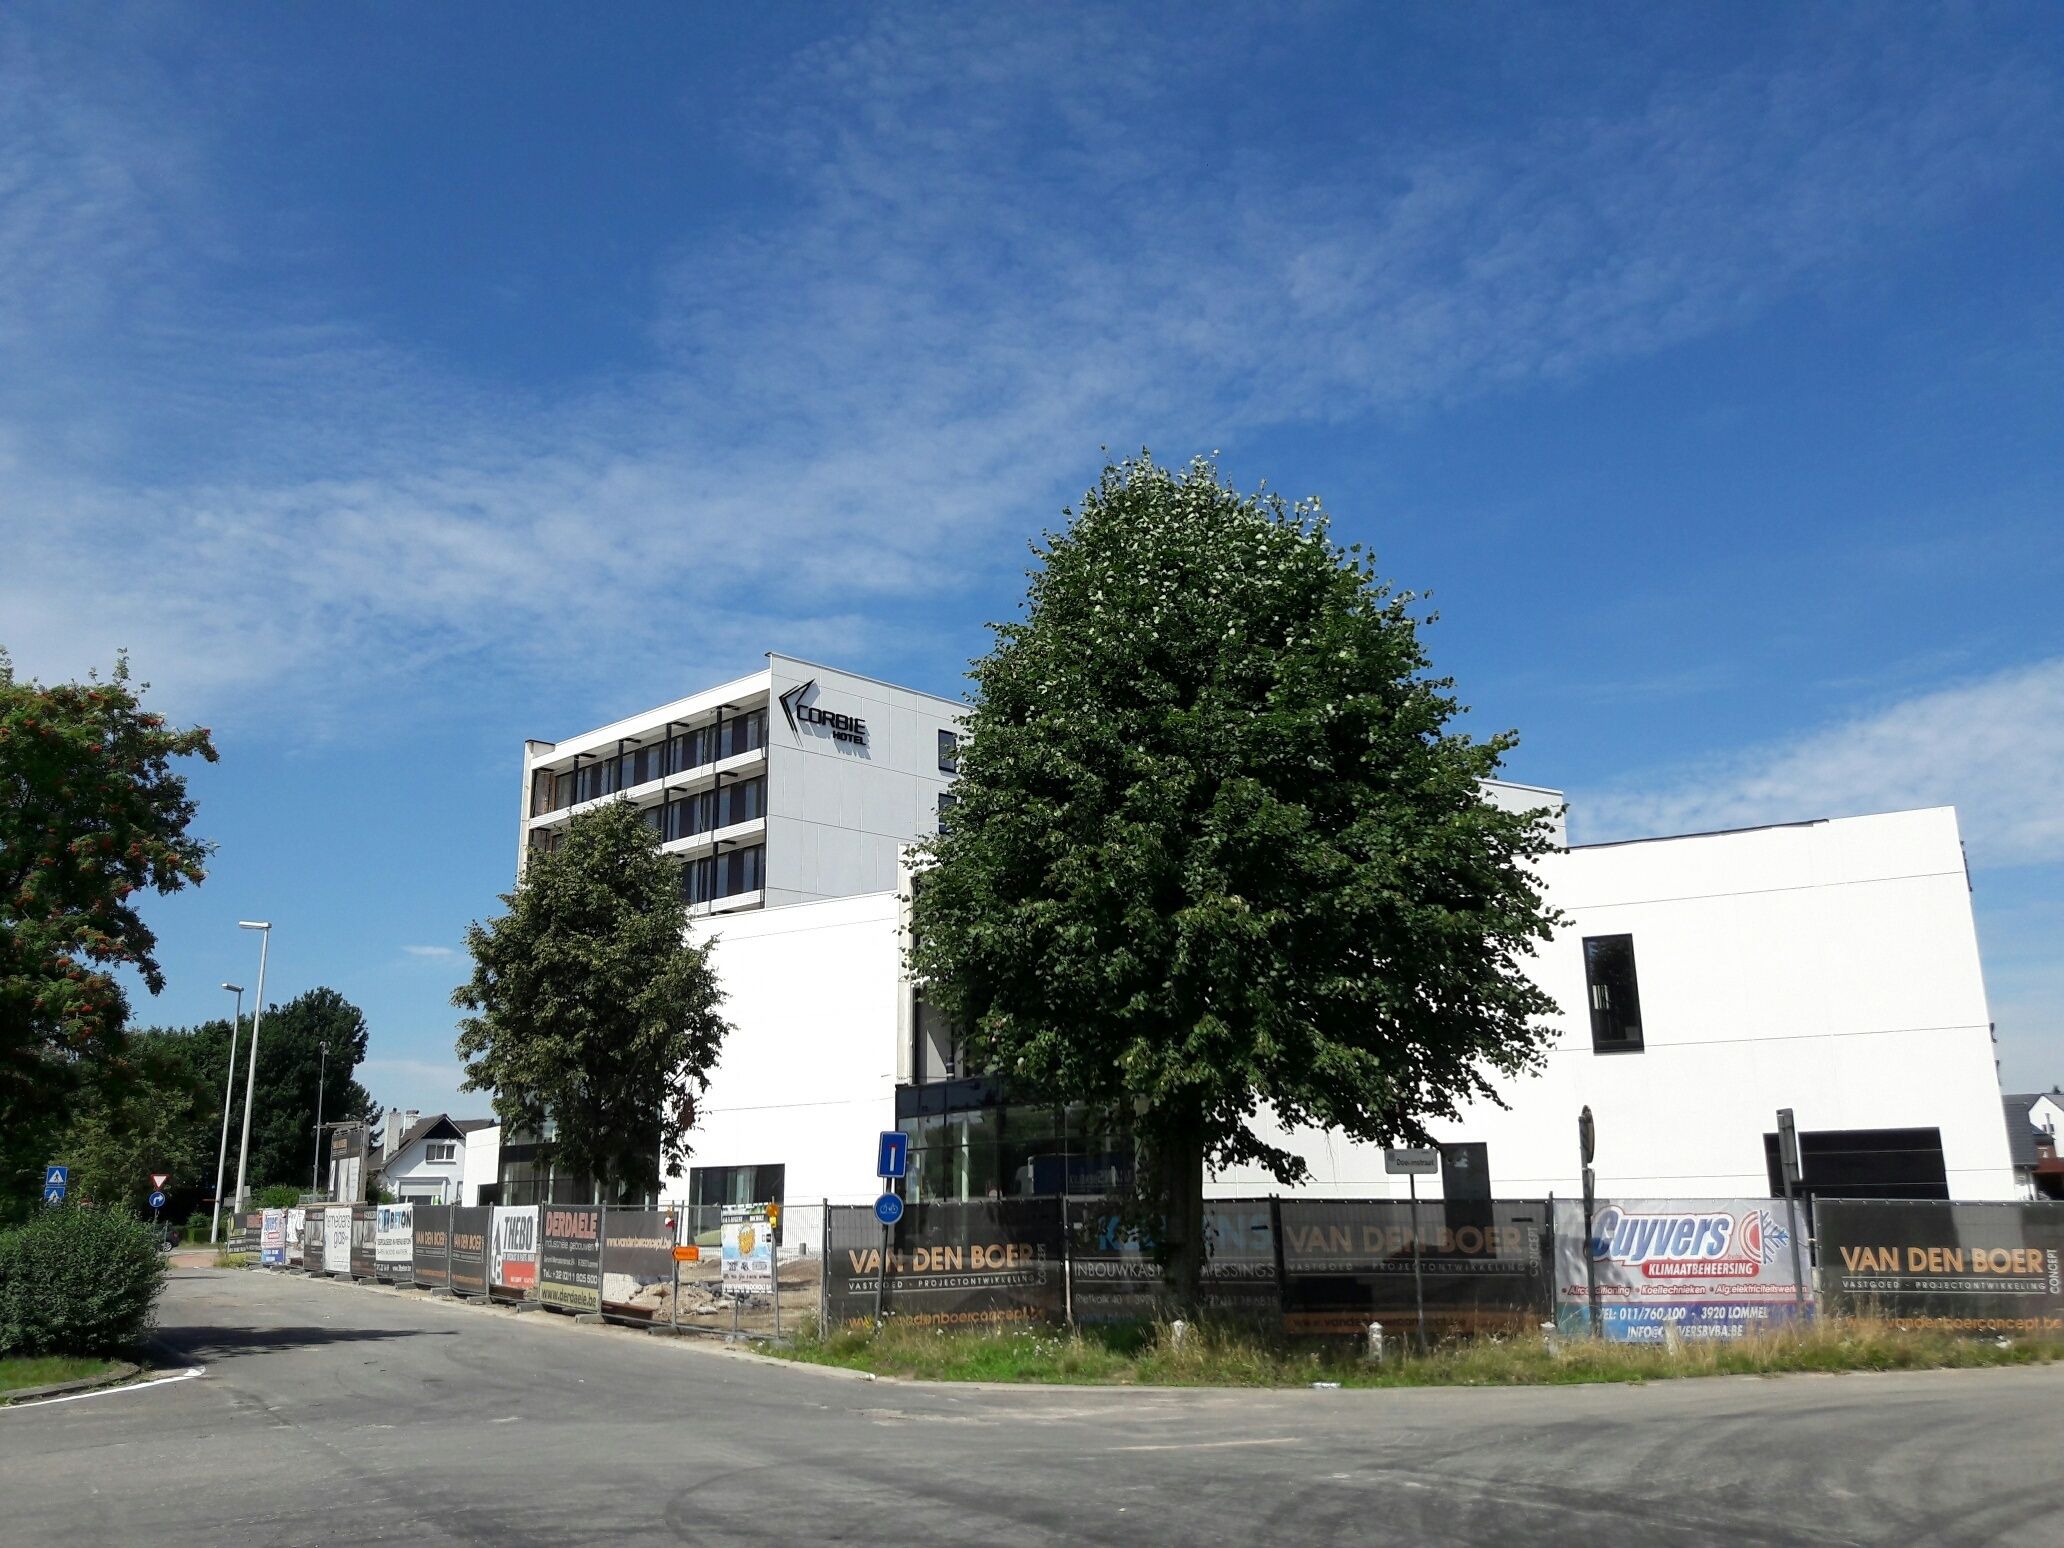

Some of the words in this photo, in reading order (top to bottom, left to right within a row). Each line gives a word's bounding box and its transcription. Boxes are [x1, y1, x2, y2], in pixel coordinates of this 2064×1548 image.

[797, 705, 866, 735] CORBIE
[833, 730, 867, 746] HOTEL
[504, 1216, 533, 1251] THEBO
[545, 1211, 598, 1240] DERDAELE
[1590, 1210, 1730, 1261] Cuyvers
[1286, 1225, 1353, 1253] VAN
[1361, 1225, 1426, 1253] DEN
[1437, 1225, 1522, 1254] BOER
[848, 1247, 904, 1274] VAN
[912, 1246, 962, 1272] DEN
[970, 1243, 1034, 1270] BOER
[1528, 1227, 1539, 1278] CONCEPT
[1840, 1247, 1899, 1272] VAN
[1908, 1247, 1964, 1273] DEN
[1970, 1248, 2044, 1274] BOER
[1074, 1263, 1166, 1278] INBOUWKAST
[1648, 1263, 1753, 1276] KLIMAATBEHEERSING
[2046, 1249, 2060, 1294] CONCEPT
[918, 1275, 1035, 1289] PROJECTONTWIKKELING
[1568, 1285, 1631, 1297] Aircoditioning
[1641, 1285, 1706, 1296] Koeltechnieken
[1715, 1284, 1808, 1296] Alg.elektriciteitswerkn
[1842, 1280, 1900, 1289] VASTGOED
[1916, 1281, 2046, 1291] PROJECTONTWIKKELING
[542, 1288, 597, 1307] www.derdaele.be
[1701, 1307, 1726, 1320] 3920
[1728, 1306, 1768, 1319] LOMMEL
[1627, 1325, 1744, 1339] INFO@CVERSBVBA.BE
